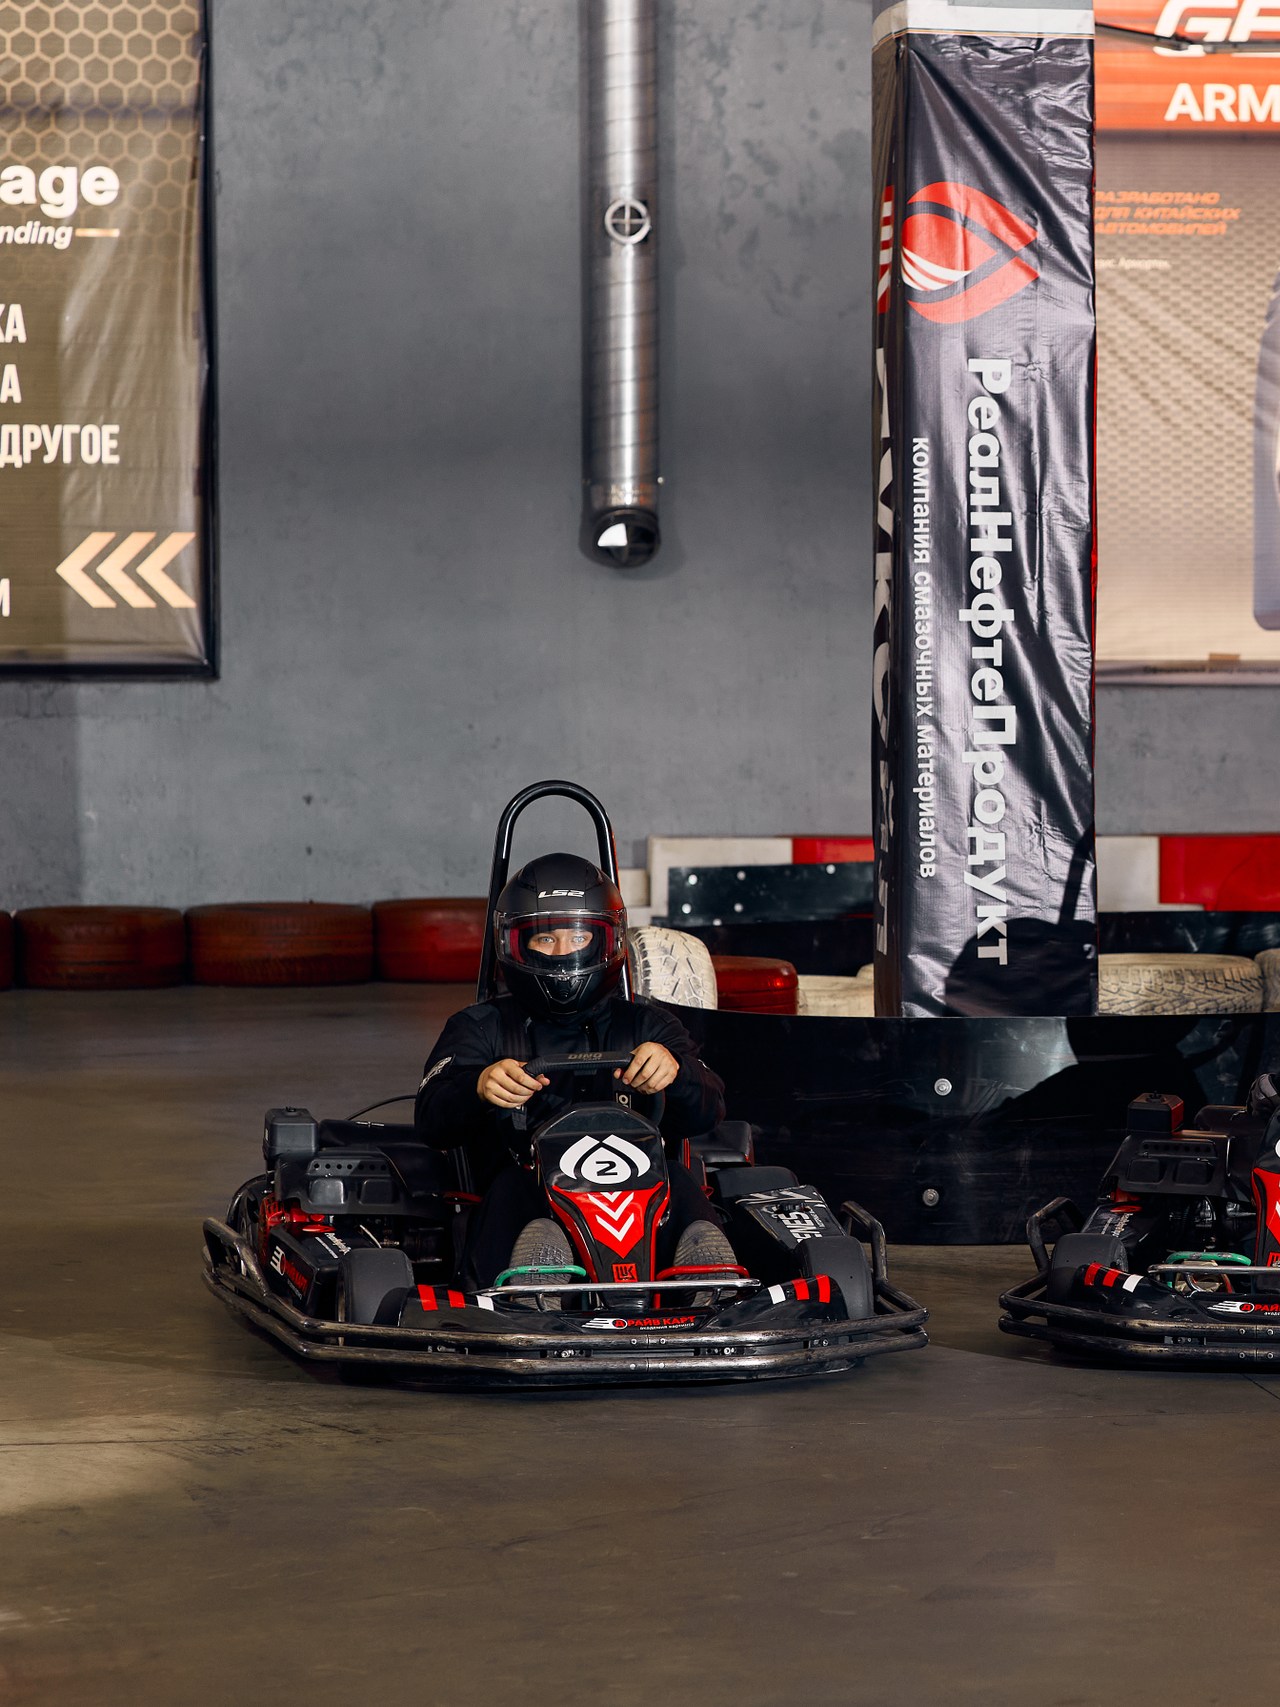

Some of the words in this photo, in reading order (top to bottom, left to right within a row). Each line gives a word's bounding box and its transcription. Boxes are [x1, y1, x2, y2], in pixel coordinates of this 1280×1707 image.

[0, 165, 120, 218] age
[0, 424, 120, 468] ДРУГОЕ
[912, 437, 931, 564] компания
[914, 571, 934, 717] смазочных
[958, 358, 1017, 966] РеалНефтеПродукт
[912, 724, 937, 879] материалов
[538, 889, 585, 898] LS2
[568, 1052, 602, 1060] DINO
[595, 1160, 618, 1177] 2
[613, 1317, 661, 1328] ДРАЙВ
[662, 1315, 697, 1326] КАРТ
